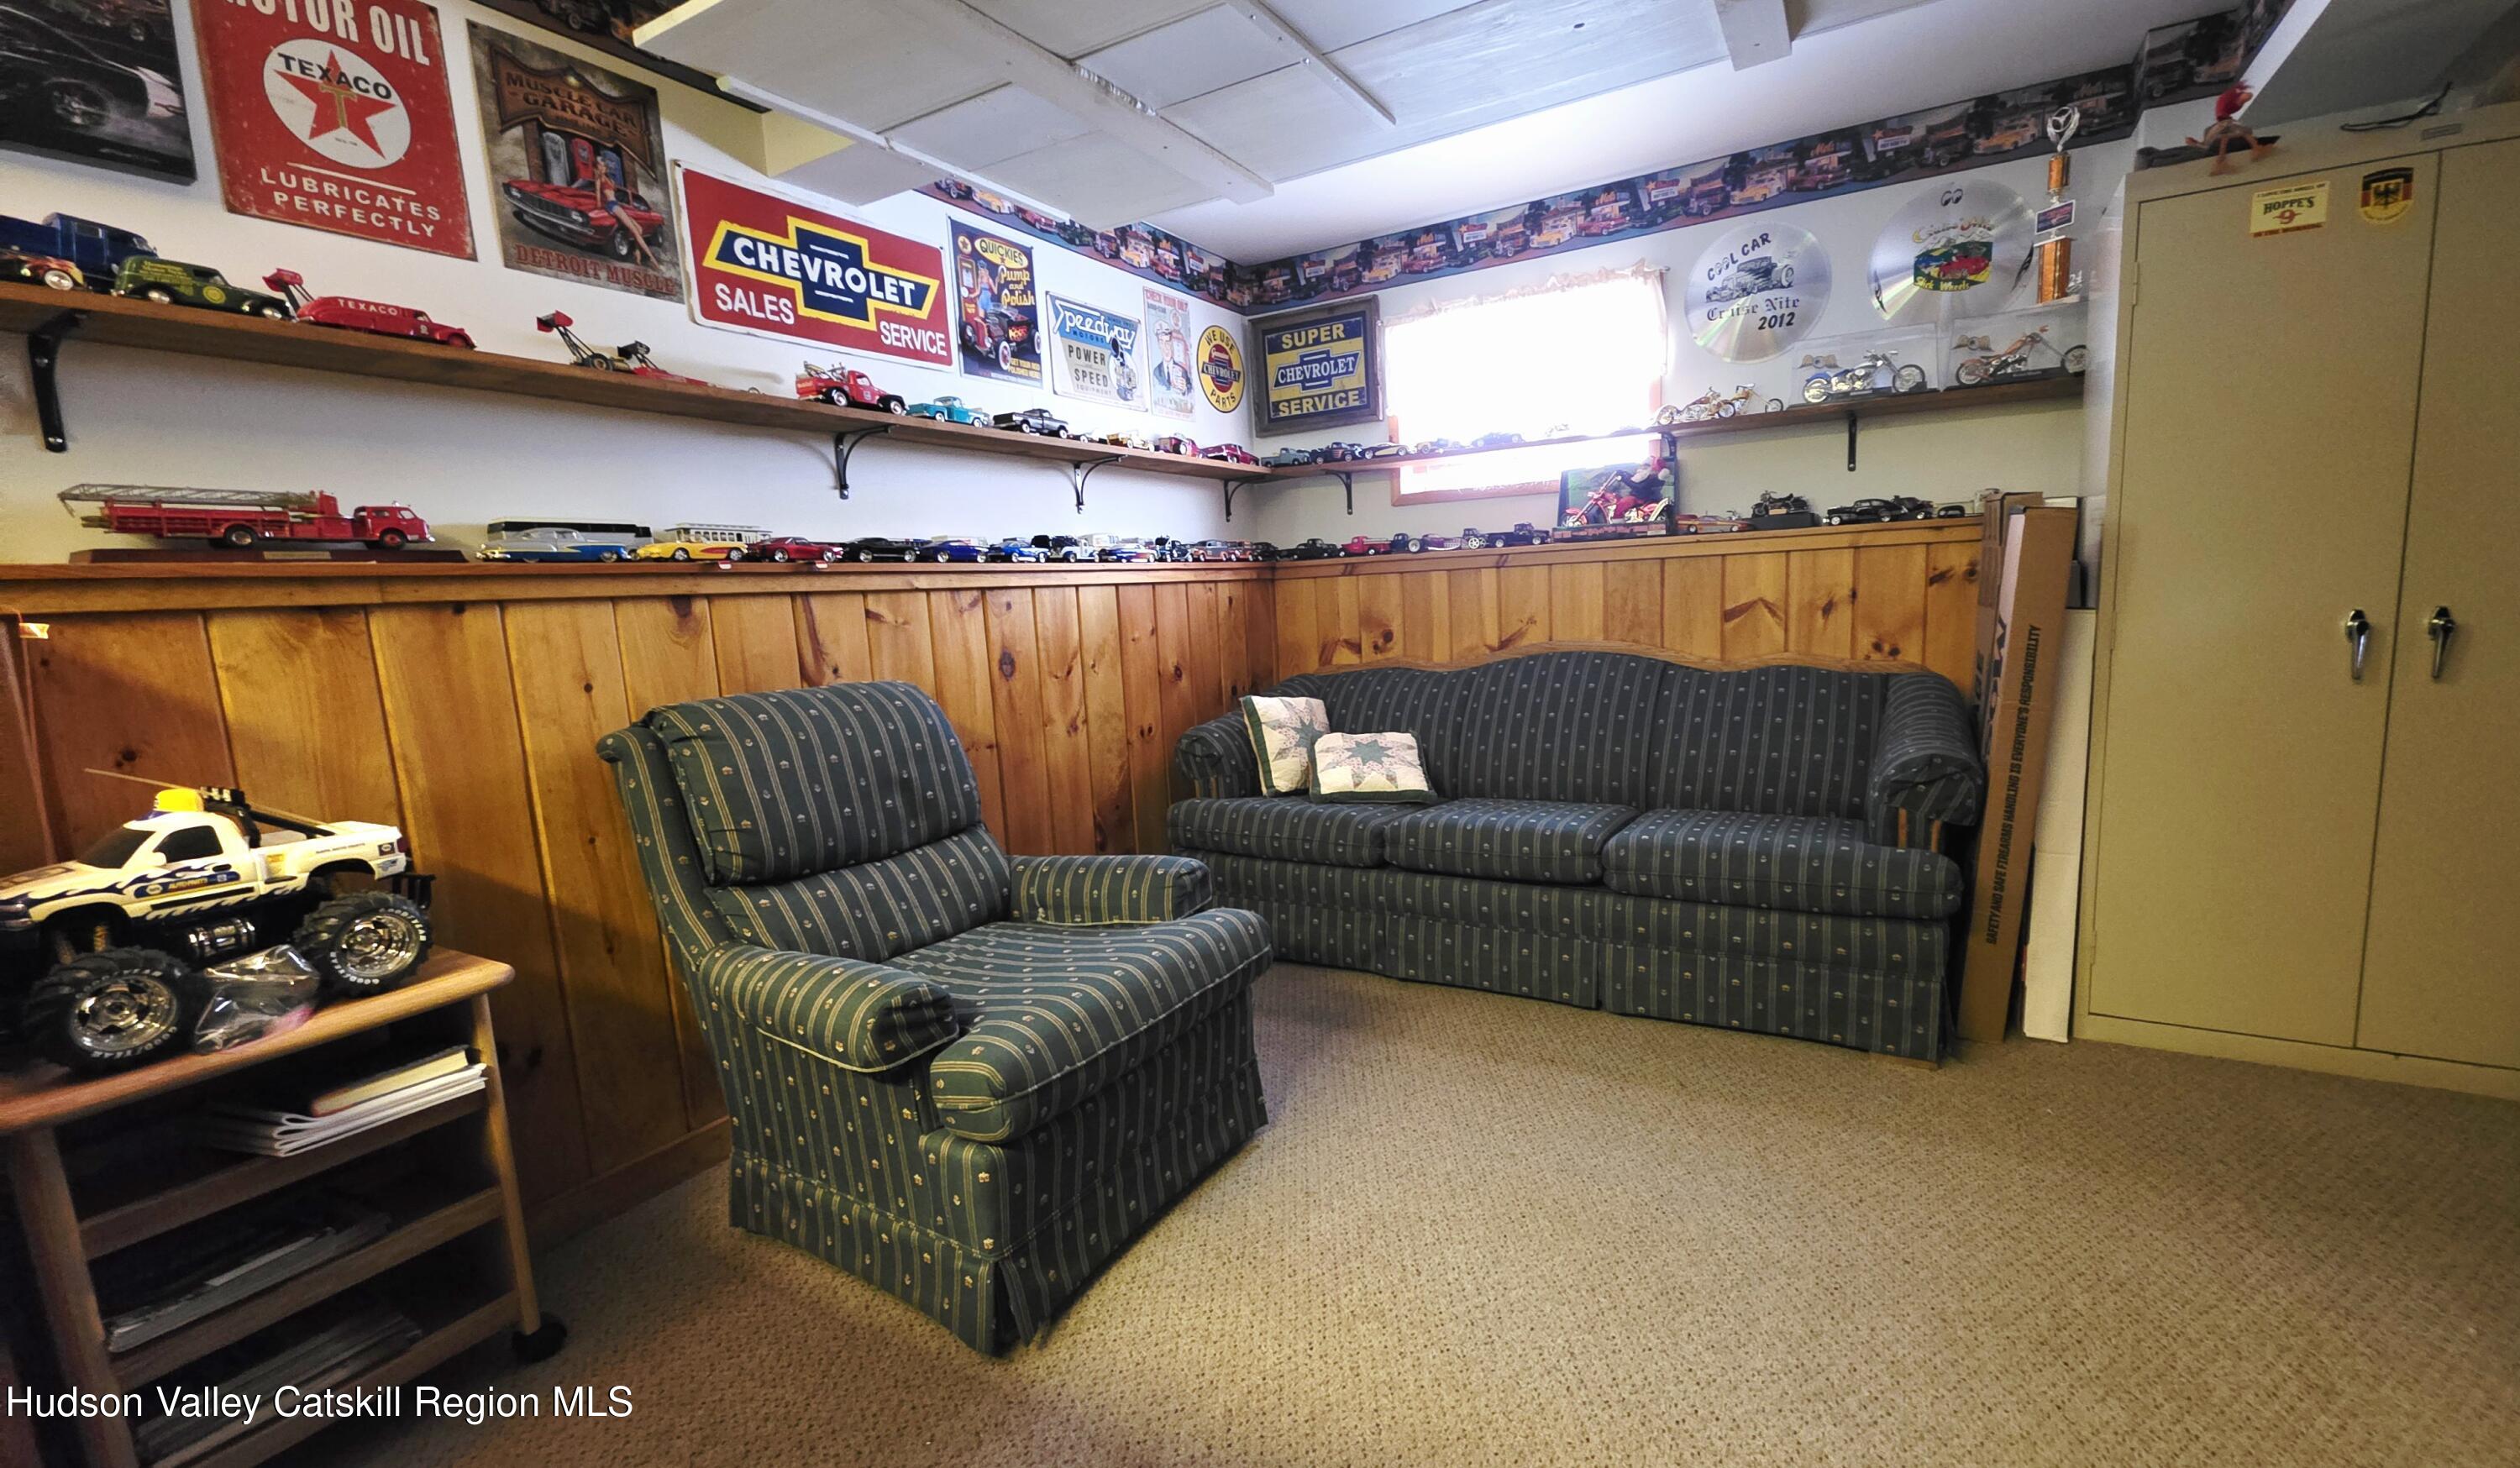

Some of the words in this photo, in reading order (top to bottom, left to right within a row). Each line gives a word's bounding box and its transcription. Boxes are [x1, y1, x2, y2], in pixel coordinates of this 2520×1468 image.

[369, 5, 429, 66] OIL
[277, 52, 392, 100] TEXACO
[506, 71, 591, 107] MUSCLE
[596, 102, 638, 128] CAR
[522, 90, 628, 138] GARAGE
[260, 167, 441, 221] LUBRICATES
[2263, 196, 2317, 215] HOPPE'S
[273, 191, 435, 238] PERFECTLY
[979, 239, 1024, 266] QUICKIES
[1707, 253, 1739, 281] COOL
[1740, 233, 1772, 256] CAR
[515, 244, 601, 280] DETROIT
[606, 264, 679, 296] MUSCLE
[733, 236, 916, 306] CHEVROLET
[997, 265, 1031, 286] Pump
[338, 298, 399, 317] TEXACO
[715, 282, 795, 325] SALES
[1000, 288, 1036, 308] Polish
[1764, 296, 1800, 312] Nite
[1052, 299, 1136, 350] Speedway
[1281, 322, 1346, 349] SUPER
[1757, 312, 1796, 331] 2012
[879, 320, 948, 357] SERVICE
[1204, 330, 1218, 346] WE
[1219, 329, 1236, 354] USE
[1068, 344, 1106, 367] POWER
[1074, 368, 1109, 388] SPEED
[1204, 363, 1240, 382] CHEVROLET
[1278, 356, 1356, 384] CHEVROLET
[1210, 388, 1236, 408] PARTS
[1278, 391, 1360, 417] SERVICE
[2019, 624, 2042, 706] RESPONSIBILITY
[2011, 705, 2030, 763] EVERYONE'S
[2008, 762, 2023, 774] IS
[2003, 774, 2020, 822] HANDLING
[1997, 821, 2013, 869] FIREARMS
[1993, 869, 2007, 893] SAFE
[1991, 893, 2003, 914] AND
[1985, 910, 2003, 945] SAFETY
